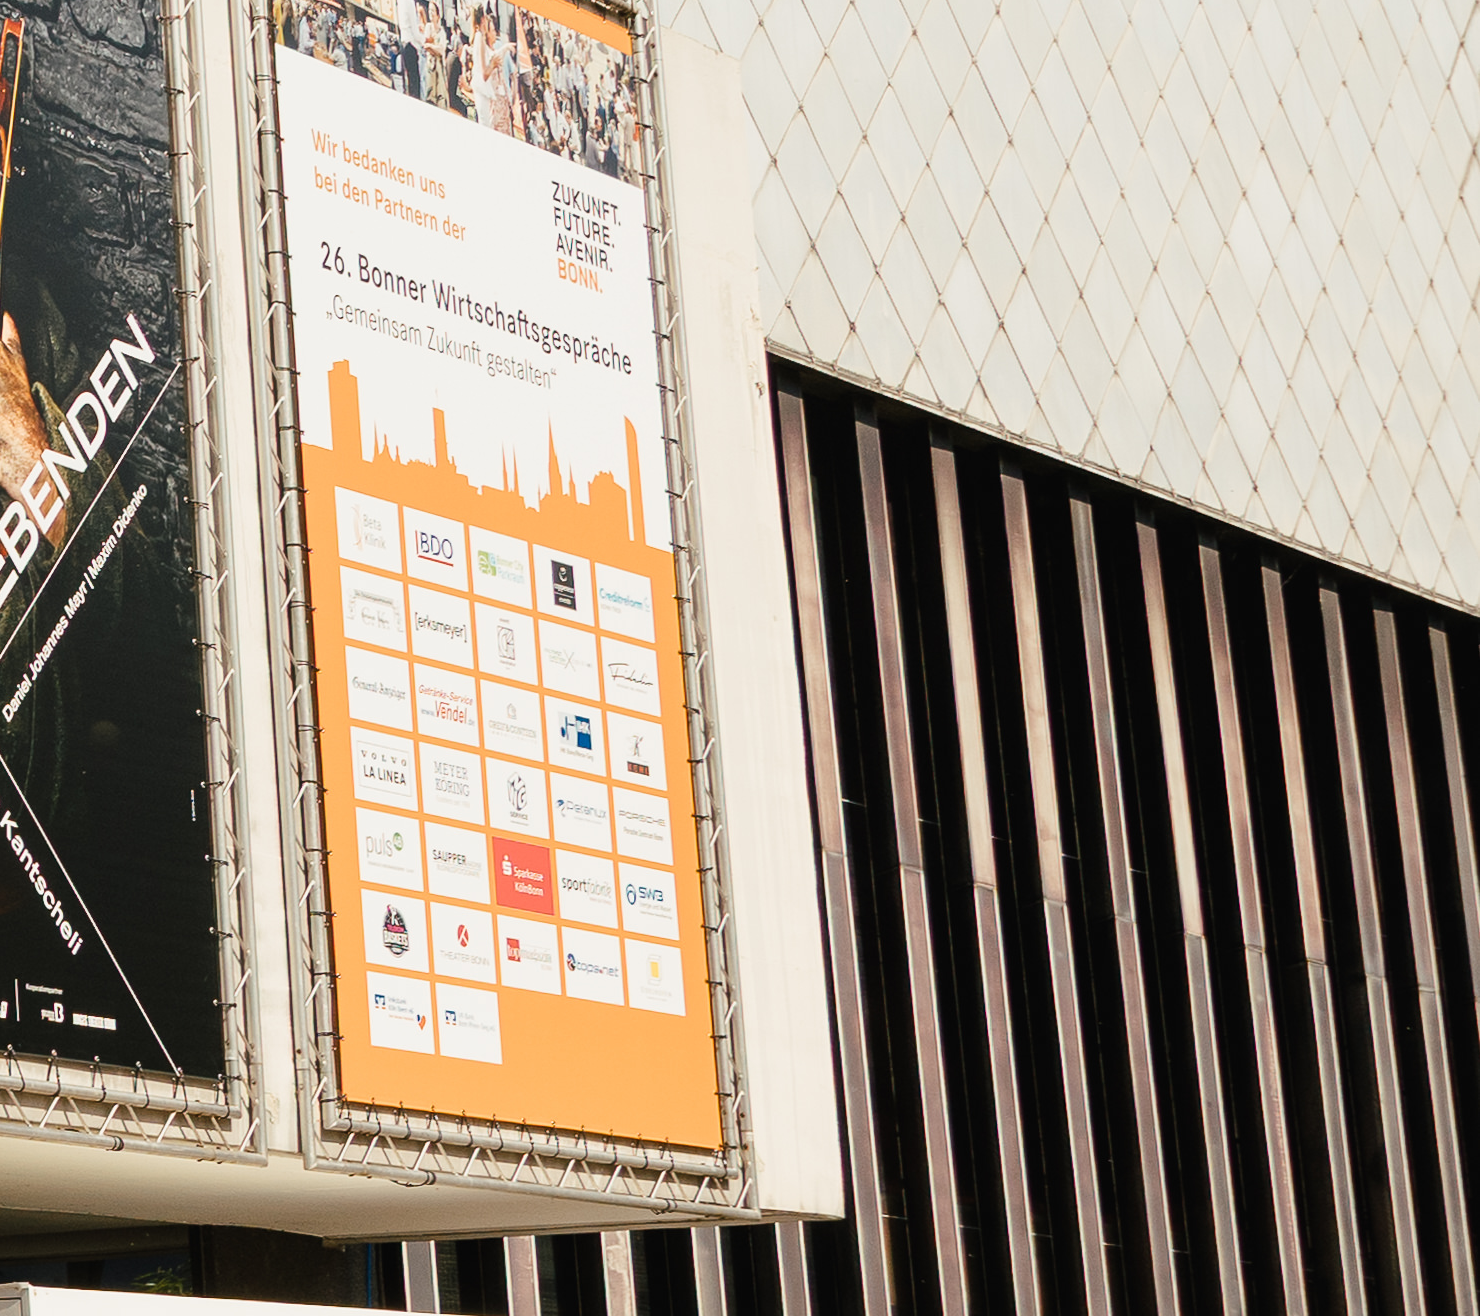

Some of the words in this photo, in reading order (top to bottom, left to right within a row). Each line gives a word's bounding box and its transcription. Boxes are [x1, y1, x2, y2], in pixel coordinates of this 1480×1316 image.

[311, 128, 337, 158] Wir
[342, 141, 415, 191] bedanken
[419, 176, 446, 199] uns
[314, 166, 337, 193] bei
[342, 177, 370, 208] den
[375, 191, 438, 234] Partnern
[442, 216, 466, 242] der
[551, 181, 621, 227] ZUKUNFT.
[554, 208, 615, 249] FUTURE.
[556, 233, 613, 273] AVENIR.
[557, 258, 603, 294] BONN.
[320, 240, 352, 278] 26.
[358, 253, 427, 305] Bonner
[431, 277, 633, 376] Wirtschaftsgespräche
[326, 294, 423, 349] „Gemeinsam
[426, 324, 483, 368] Zukunft
[486, 348, 557, 387] gestalten“
[419, 531, 454, 560] BDO
[1, 673, 33, 723] Daniel
[28, 614, 70, 682] Johannes
[63, 581, 88, 619] Mayr
[86, 533, 118, 580] Maxim
[111, 483, 149, 538] Didenko
[363, 764, 376, 780] LA
[377, 768, 407, 786] LINEA
